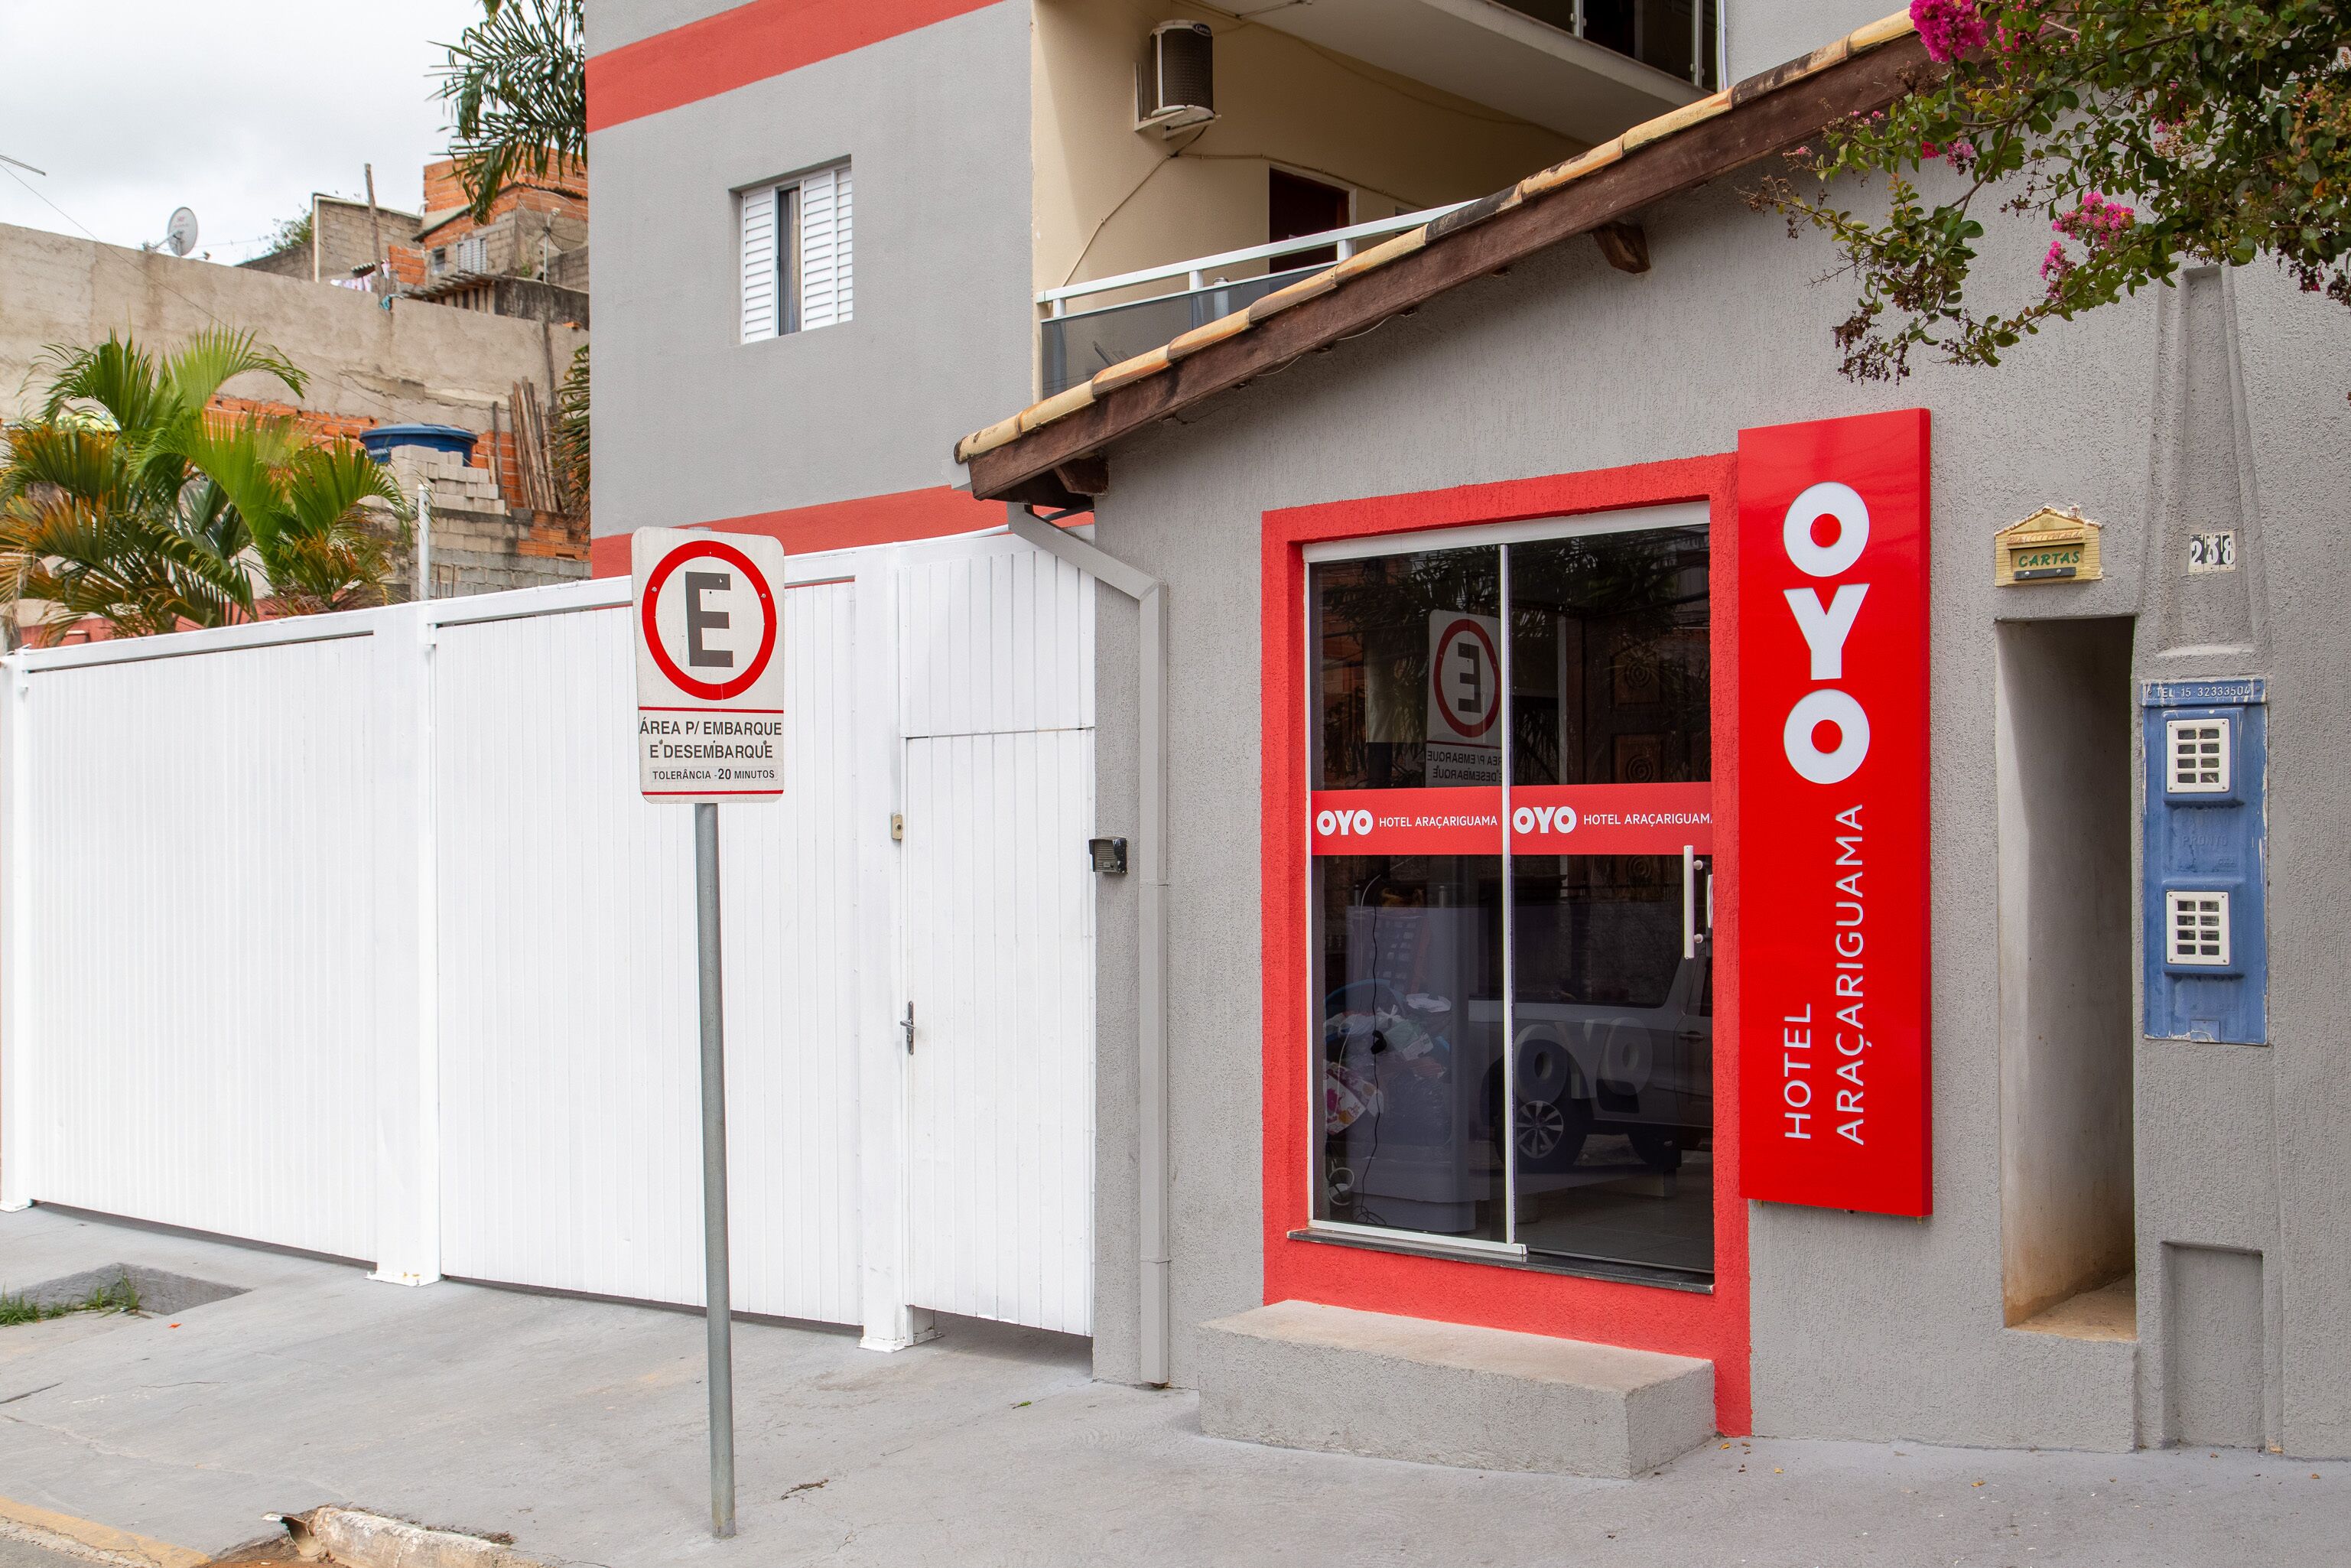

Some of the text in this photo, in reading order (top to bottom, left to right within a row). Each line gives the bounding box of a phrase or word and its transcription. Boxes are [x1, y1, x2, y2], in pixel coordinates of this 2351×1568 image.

[2018, 551, 2079, 568] CARTAS
[685, 571, 733, 668] E
[1784, 481, 1870, 784] OYO
[2157, 687, 2174, 698] TEL
[639, 717, 782, 736] ÁREA P/ EMBARQUE
[650, 744, 773, 759] E DESEMBARQUE
[652, 768, 711, 779] TOLERÂNCIA
[734, 769, 775, 779] MINUTOS
[1316, 809, 1497, 836] OYO HOTEL ARAÇARIGUAMA
[1513, 805, 1712, 834] OYO HOTEL ARAÇARIGUAM
[1836, 804, 1872, 1145] ARAÇARIGUAMA
[1784, 1003, 1811, 1140] HOTEL
